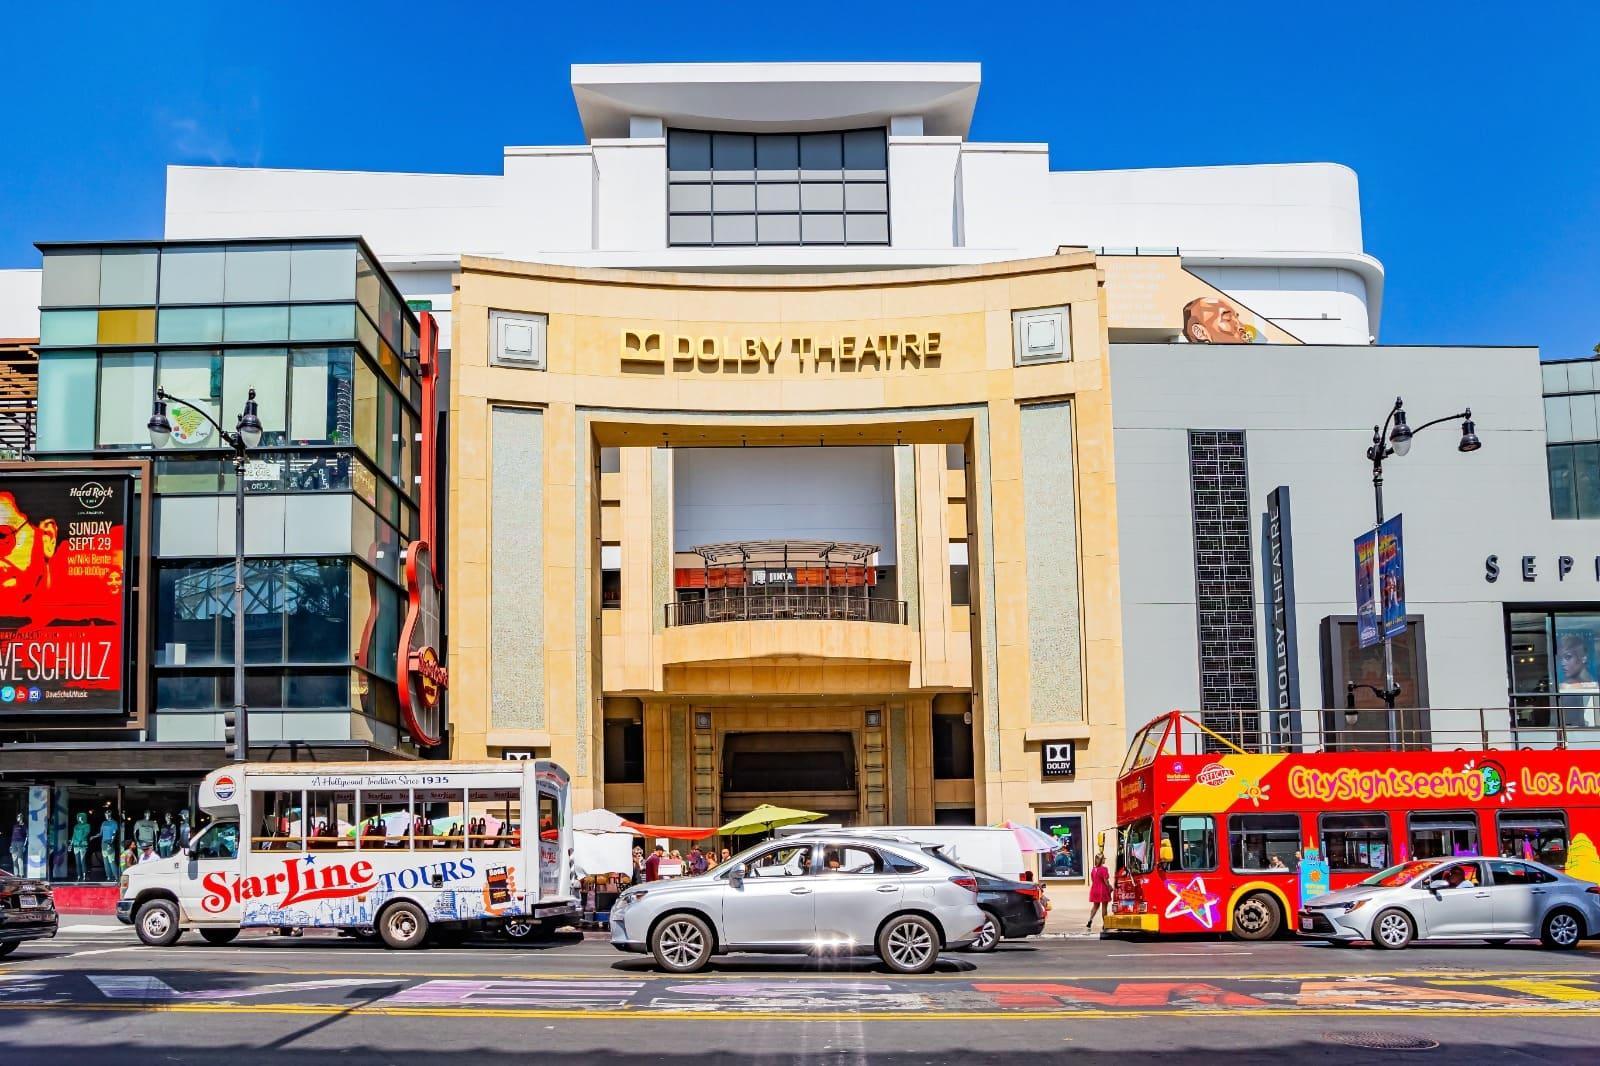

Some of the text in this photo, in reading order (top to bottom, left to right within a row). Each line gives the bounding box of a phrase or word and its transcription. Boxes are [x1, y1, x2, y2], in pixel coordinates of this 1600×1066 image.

[672, 333, 941, 373] DOLBY THEATRE
[70, 486, 114, 498] Hard Rock
[68, 521, 112, 536] SUNDAY
[68, 537, 112, 551] SEPT. 29
[1270, 505, 1290, 708] DOLBY THEATRE
[27, 641, 112, 680] SCHULZ
[1046, 762, 1070, 770] DOLBY
[322, 776, 363, 788] Hollywood
[365, 776, 397, 786] Tradition
[398, 775, 418, 785] Since
[421, 776, 449, 784] 1935
[1201, 769, 1231, 782] OFFICIAL
[1288, 765, 1484, 802] CitySightseeing
[1521, 767, 1562, 795] Los
[379, 857, 476, 893] TOURS
